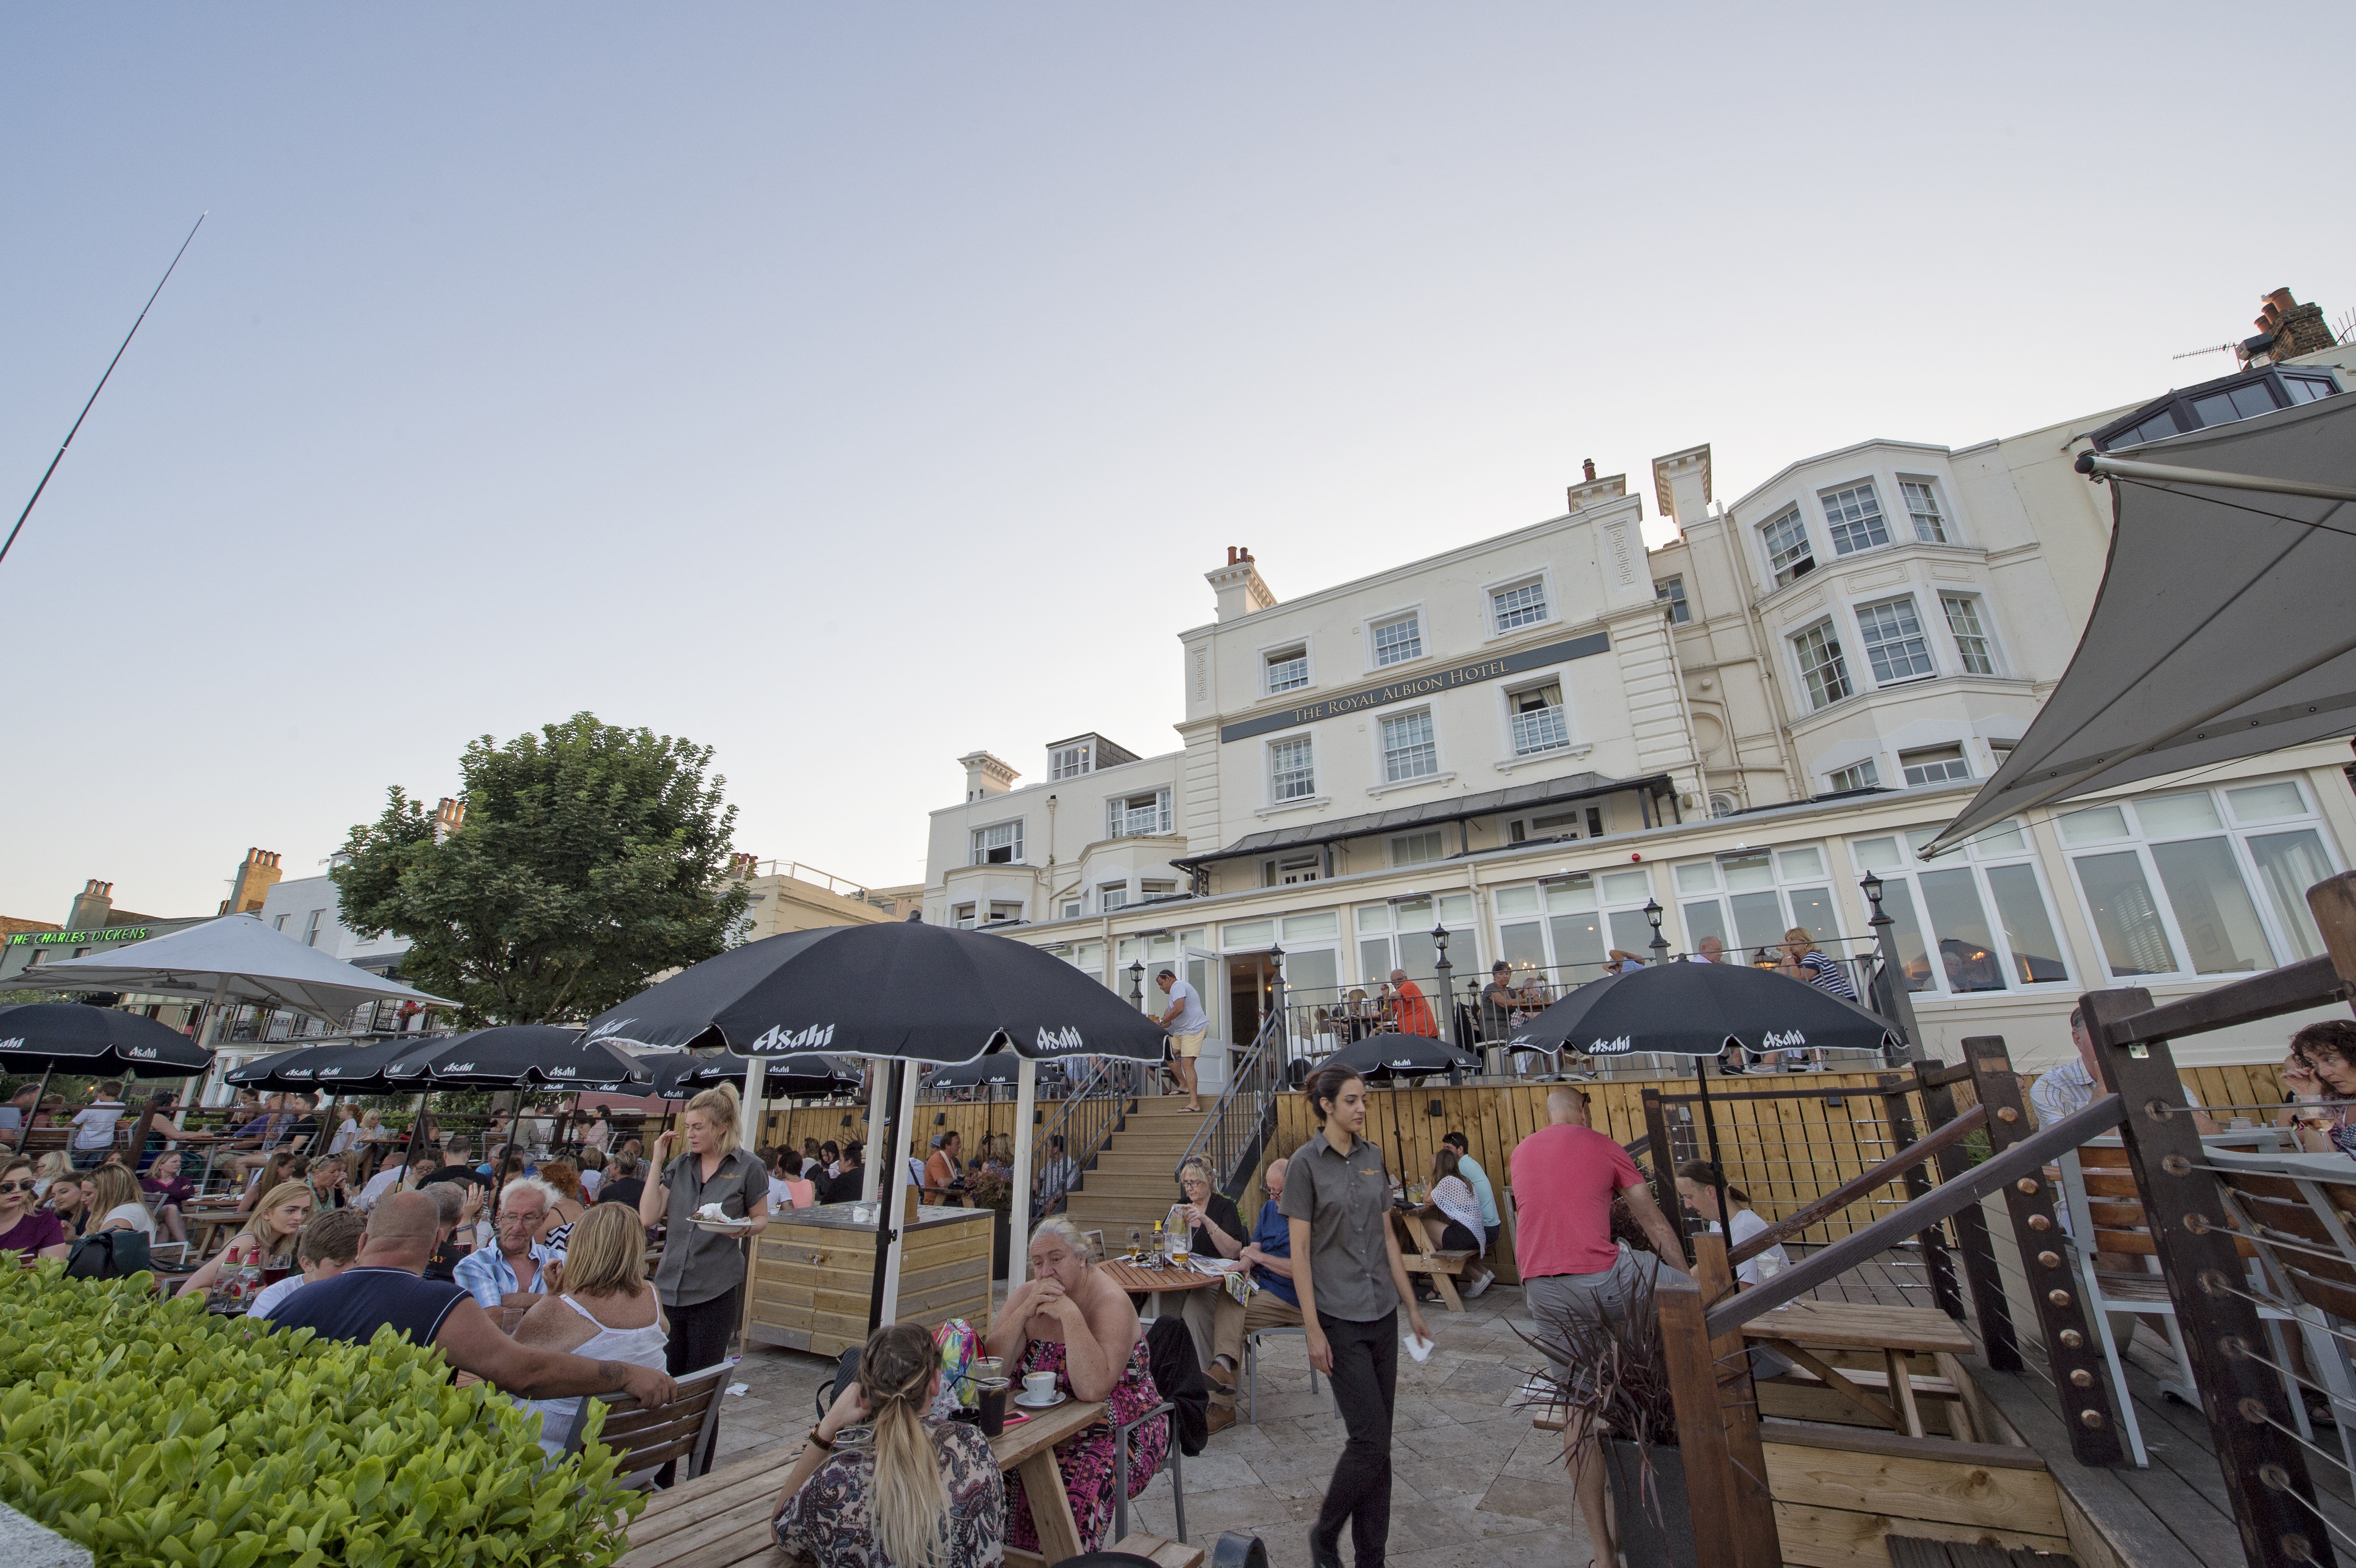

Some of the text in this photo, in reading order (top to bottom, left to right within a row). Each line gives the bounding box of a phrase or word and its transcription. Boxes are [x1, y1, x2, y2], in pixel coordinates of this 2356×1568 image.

[1293, 660, 1509, 722] THE ROYAL ALBION HOTEL
[7, 928, 146, 945] THE CHARLES DICKENS
[0, 1037, 25, 1048] ahi
[753, 1024, 835, 1051] Asahi
[1036, 1025, 1083, 1050] Asahi
[1763, 1029, 1806, 1048] Asahi
[1589, 1035, 1630, 1054] Asahi
[129, 1046, 157, 1058] Asahi
[285, 1068, 313, 1077] Asahi
[319, 1067, 342, 1076] Asahi
[443, 1062, 476, 1072] Asahi
[549, 1066, 576, 1077] Asahi
[700, 1067, 721, 1075] Asahi
[769, 1065, 789, 1074] Asahi
[664, 1090, 683, 1098] Asahi
